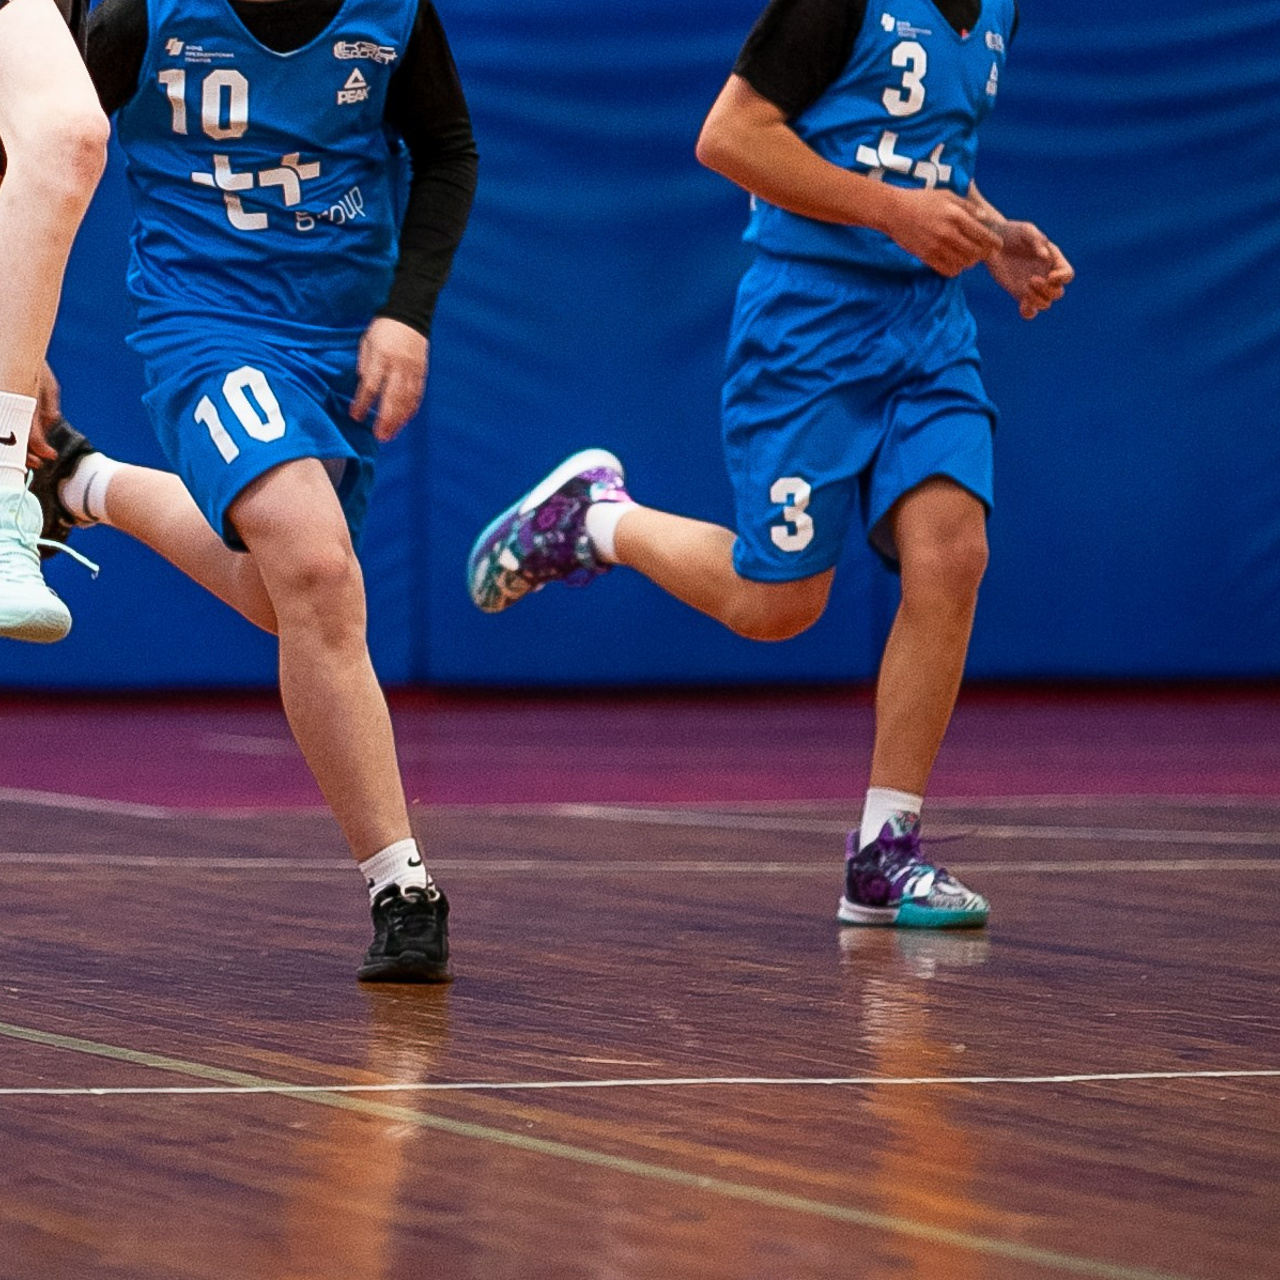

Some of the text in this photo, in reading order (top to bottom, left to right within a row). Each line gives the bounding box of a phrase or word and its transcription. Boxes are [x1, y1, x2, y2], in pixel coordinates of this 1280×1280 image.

[158, 68, 249, 141] 10
[883, 41, 927, 117] 3
[194, 365, 286, 464] 10
[770, 477, 814, 552] 3
